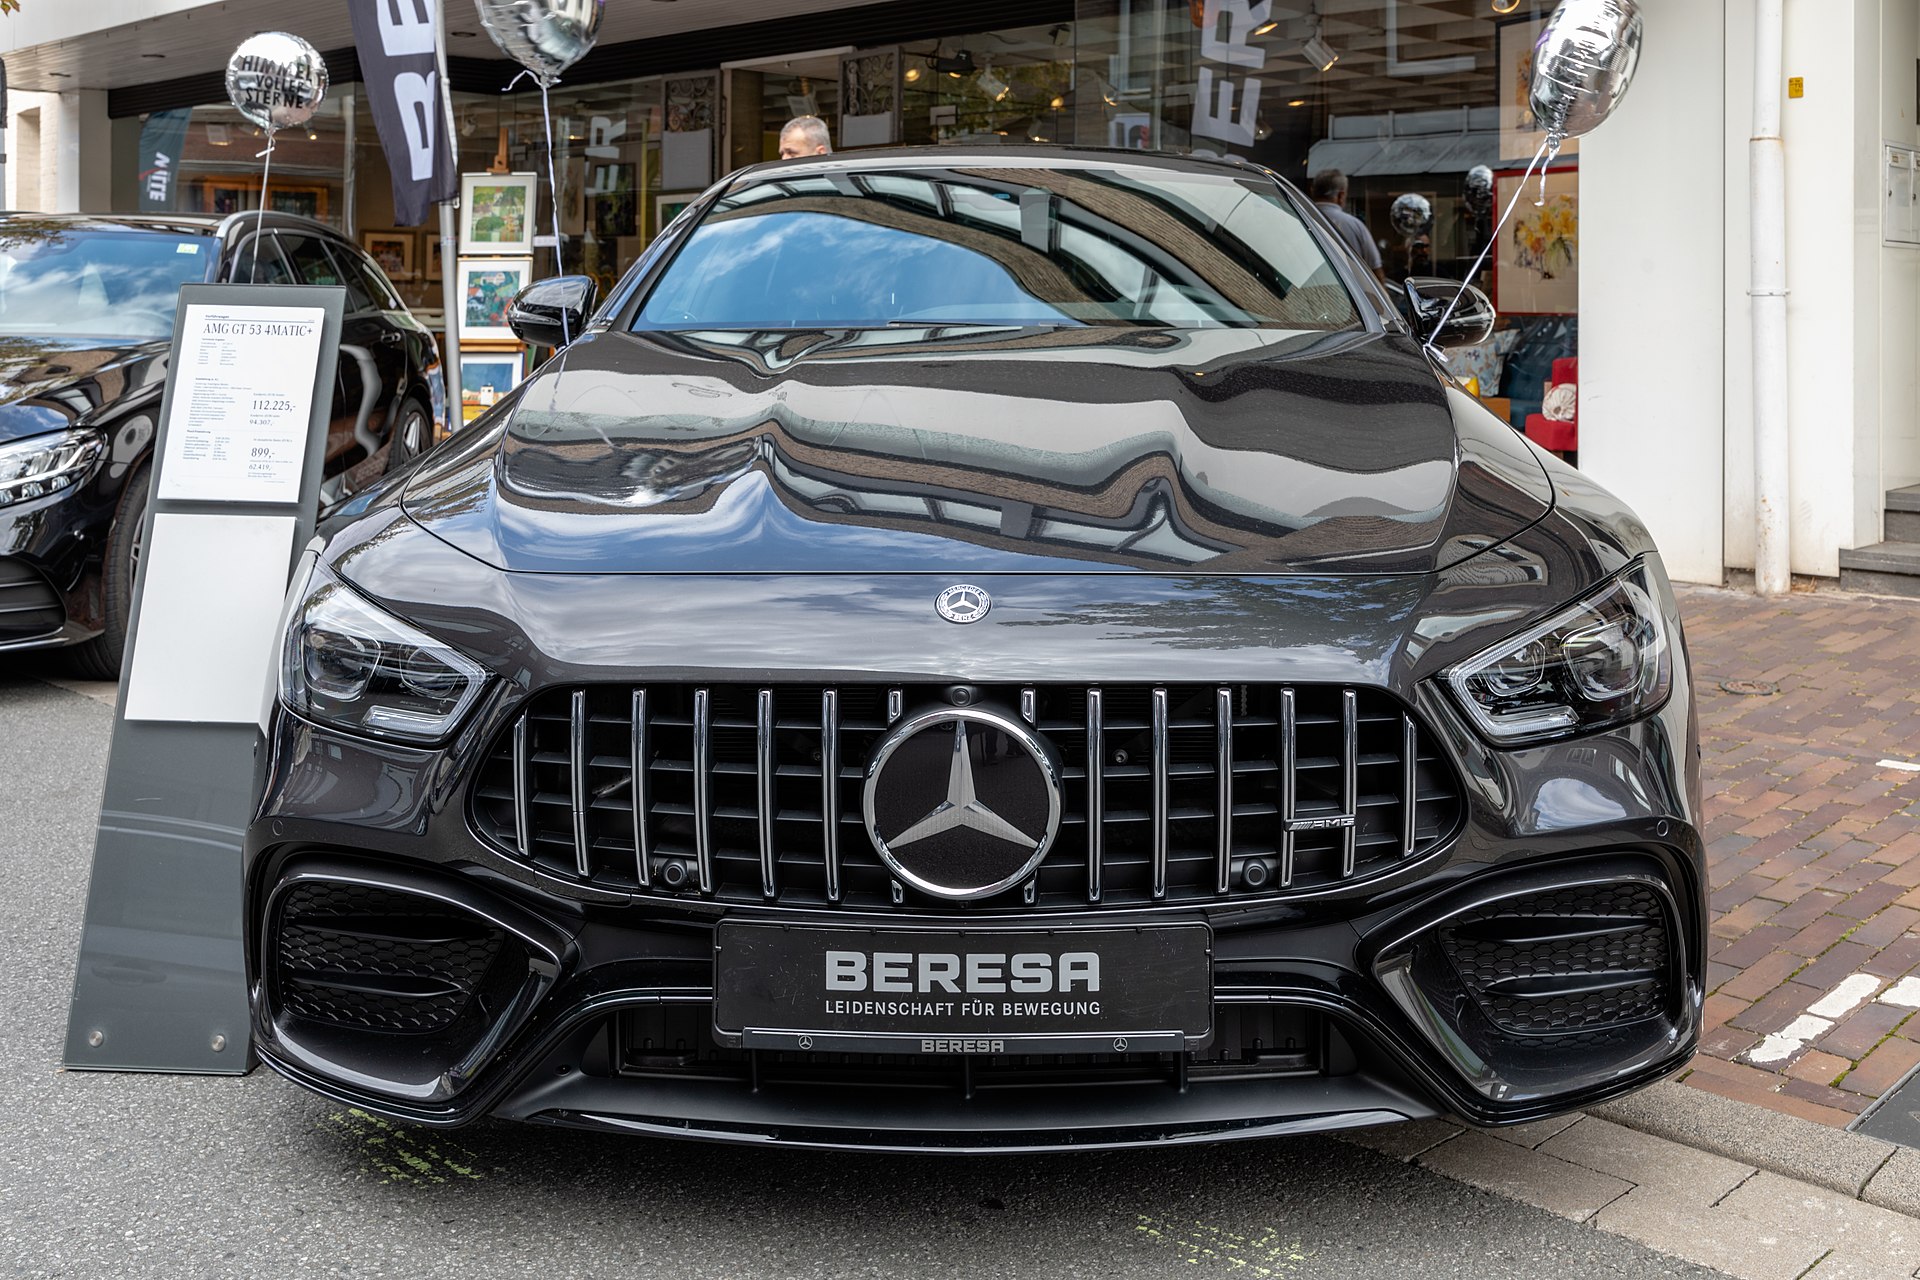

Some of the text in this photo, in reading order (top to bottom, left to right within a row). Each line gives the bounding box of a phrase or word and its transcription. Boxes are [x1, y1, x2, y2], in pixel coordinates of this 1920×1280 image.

[256, 74, 312, 94] VOLLER
[245, 87, 304, 109] STERNE
[203, 323, 313, 337] AMG GT 53 4MATIC+
[252, 400, 297, 412] 112.225,-
[251, 447, 276, 459] 899,-
[1310, 817, 1354, 829] AMG
[825, 950, 1100, 993] BERESA
[825, 999, 1101, 1016] LEIDENSCHAFT FÜR BEWEGUNG
[921, 1039, 1005, 1053] BERESA
